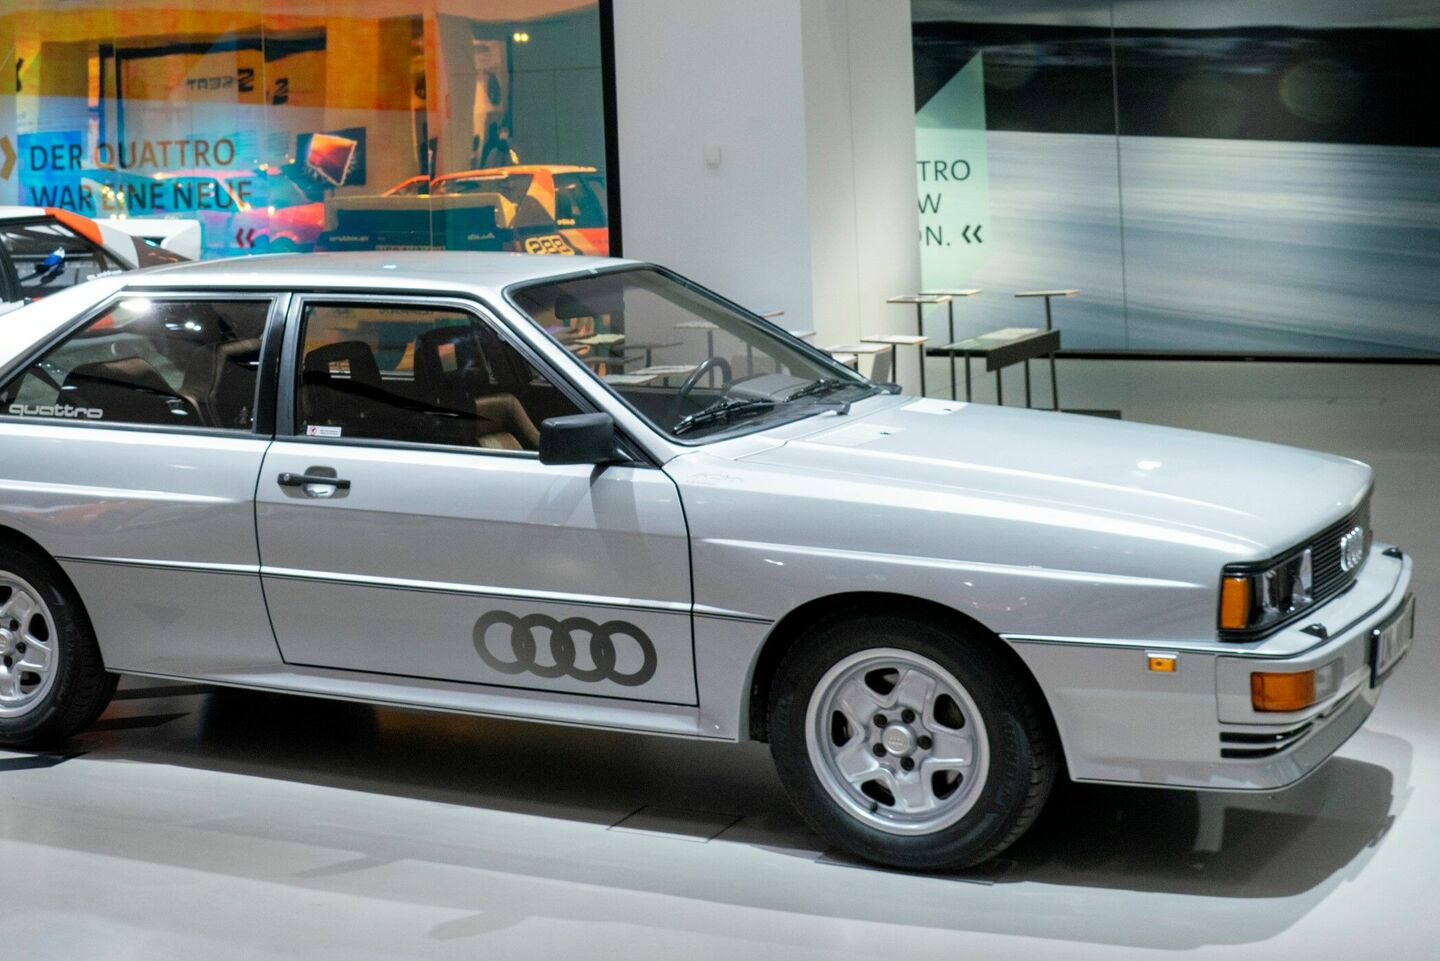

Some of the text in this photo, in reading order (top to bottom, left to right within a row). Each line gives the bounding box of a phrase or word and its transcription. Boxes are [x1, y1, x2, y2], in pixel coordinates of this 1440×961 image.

[29, 138, 236, 171] DER QUATTRO
[30, 185, 93, 211] WAR
[101, 182, 164, 210] EINE
[918, 225, 951, 246] N.
[8, 403, 104, 419] quattro
